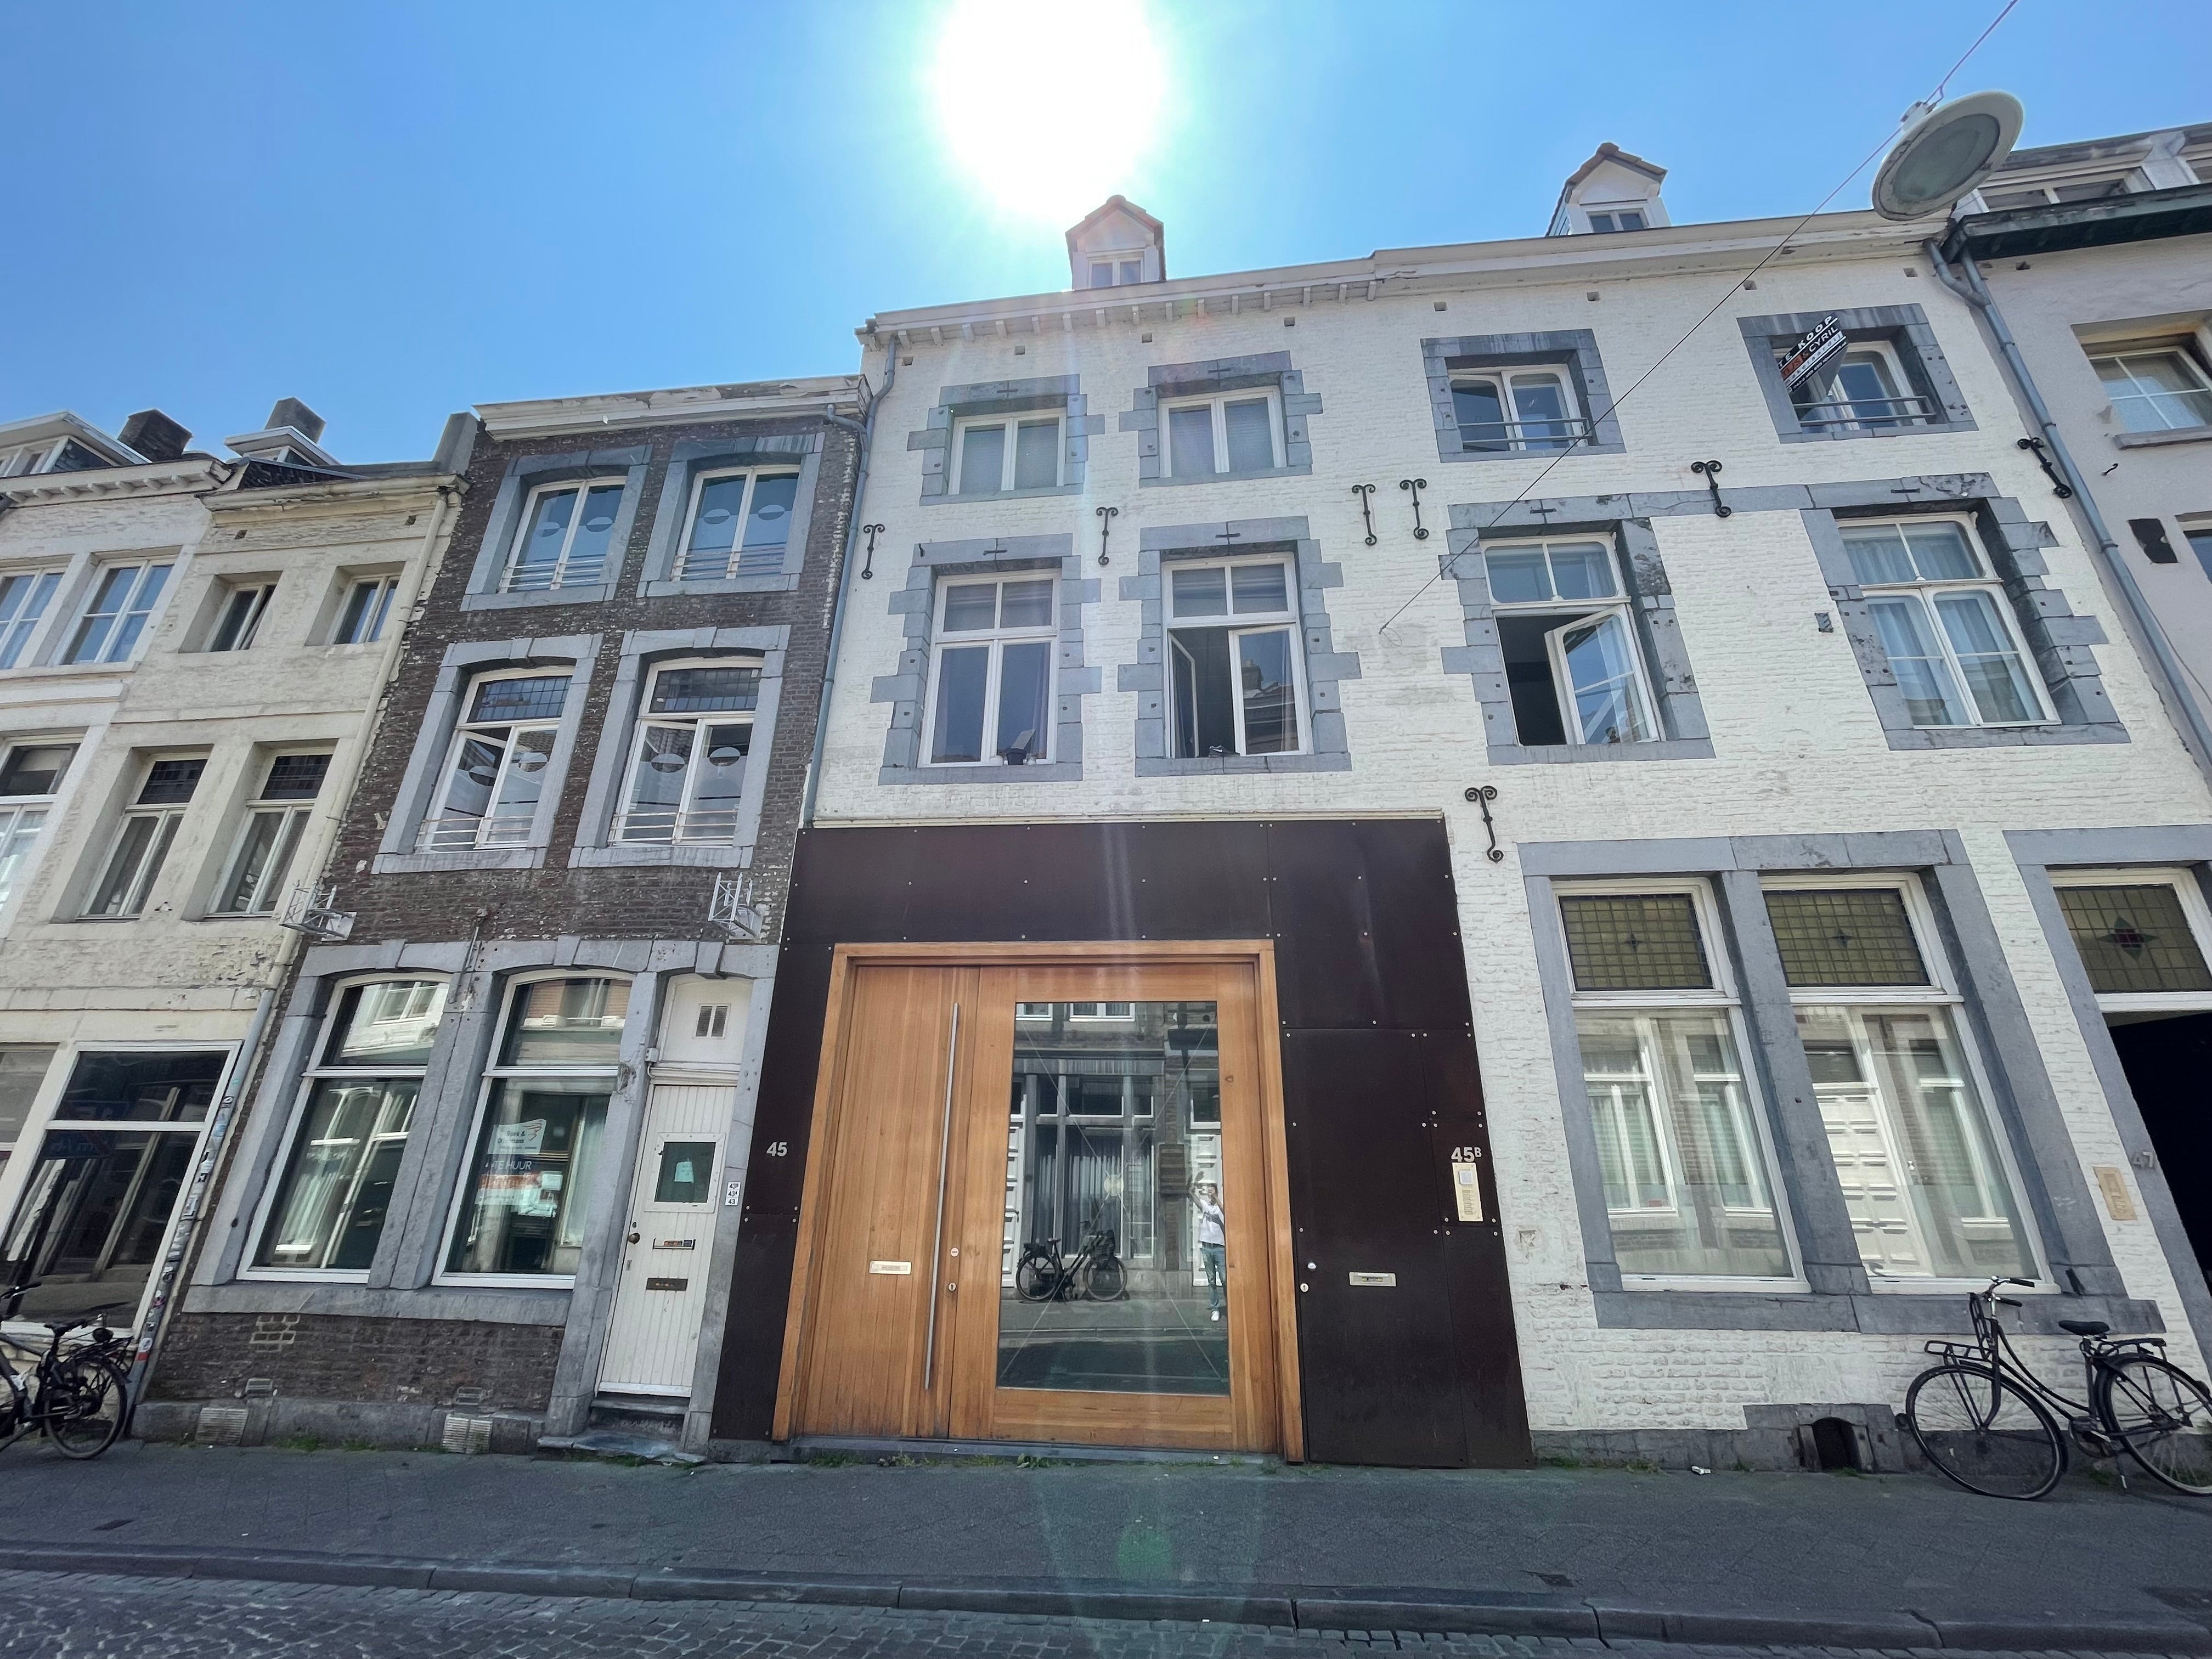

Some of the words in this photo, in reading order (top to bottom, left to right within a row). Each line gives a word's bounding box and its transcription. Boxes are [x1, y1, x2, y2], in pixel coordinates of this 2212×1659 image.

[1778, 352, 1792, 367] TE
[1797, 315, 1832, 349] KOOP
[1809, 327, 1839, 352] CYRIL
[766, 1142, 788, 1157] 45
[1451, 1147, 1482, 1163] 45B
[494, 1160, 504, 1170] TE
[505, 1160, 532, 1170] HUUR
[2132, 1152, 2154, 1168] 47
